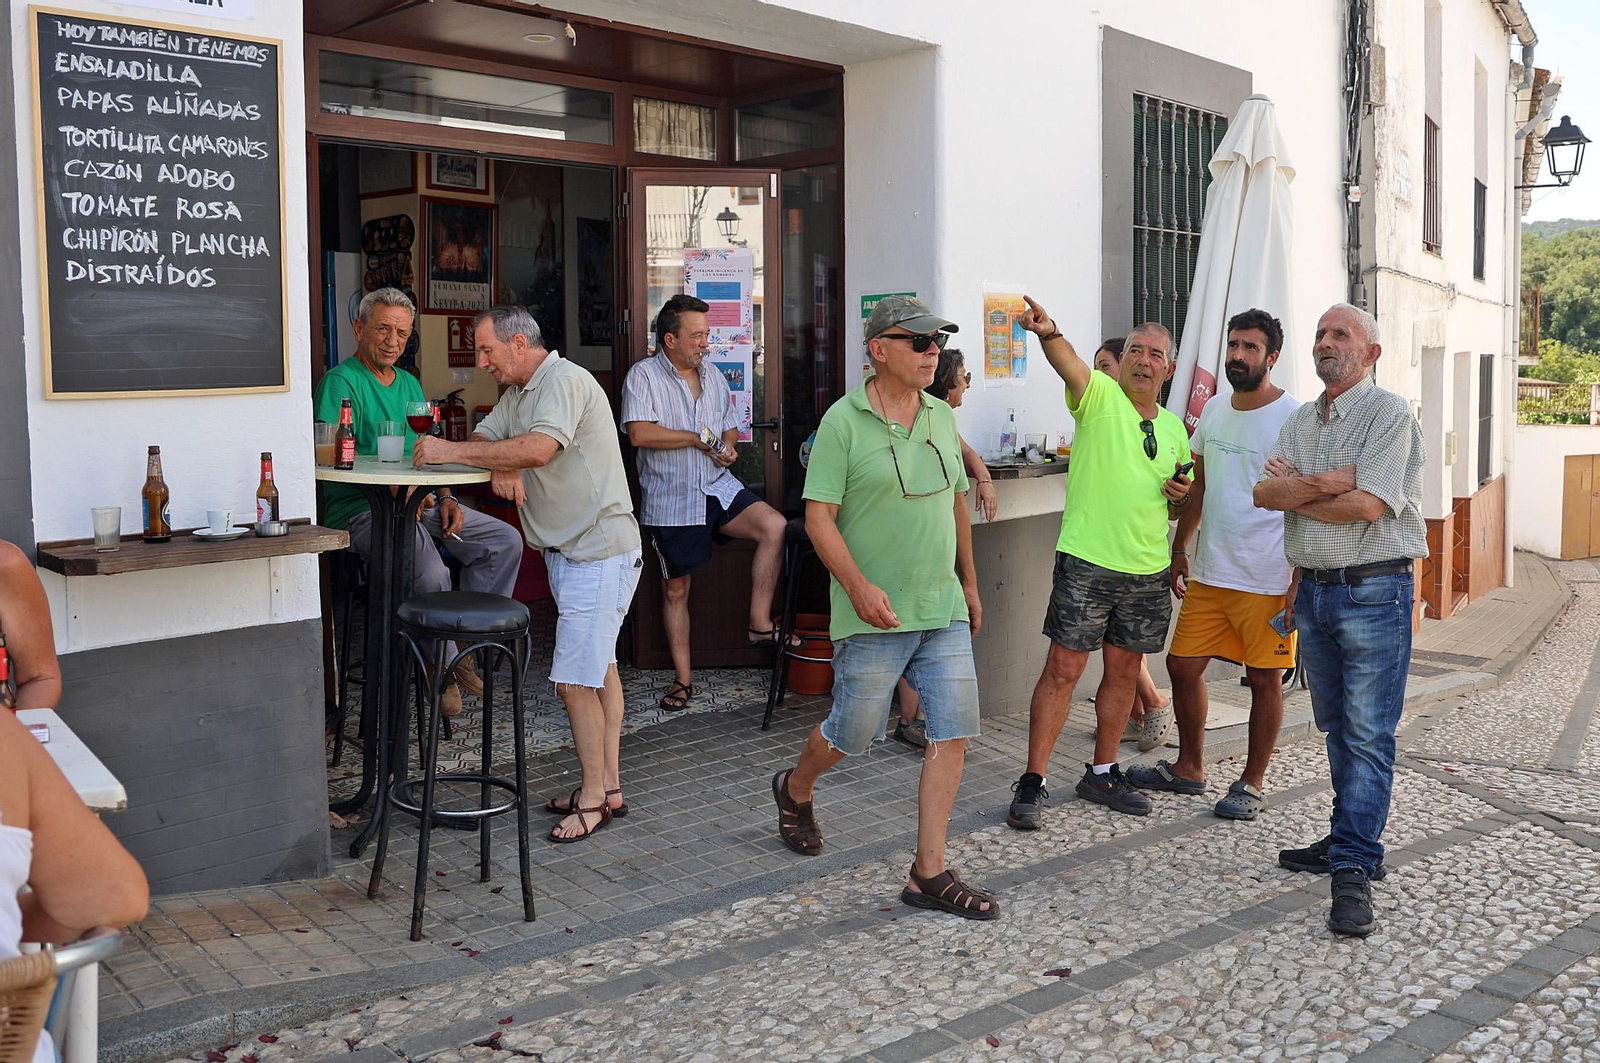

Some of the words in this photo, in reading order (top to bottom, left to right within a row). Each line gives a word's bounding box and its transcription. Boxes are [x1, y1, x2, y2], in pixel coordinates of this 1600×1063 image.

[55, 20, 97, 42] HOY
[97, 25, 181, 52] TAMBIÉN
[185, 37, 270, 62] TENEMOS
[54, 52, 203, 87] ENSALADILLA
[57, 87, 134, 114] PAPAS
[147, 91, 262, 121] ALIÑADAS
[168, 133, 269, 160] CAMARONES
[64, 159, 143, 183] CAZÓN
[157, 163, 236, 191] ADOBO
[62, 192, 159, 218] TOMATE
[176, 197, 243, 222] ROSA
[62, 225, 159, 254] CHIPIRÓN
[171, 230, 271, 259] PLANCHA
[65, 254, 217, 288] DISTRAÍDOS
[433, 282, 461, 291] SEMANA
[463, 284, 485, 293] SANTA
[466, 300, 486, 311] 2023
[449, 355, 475, 364] EXTINTOR
